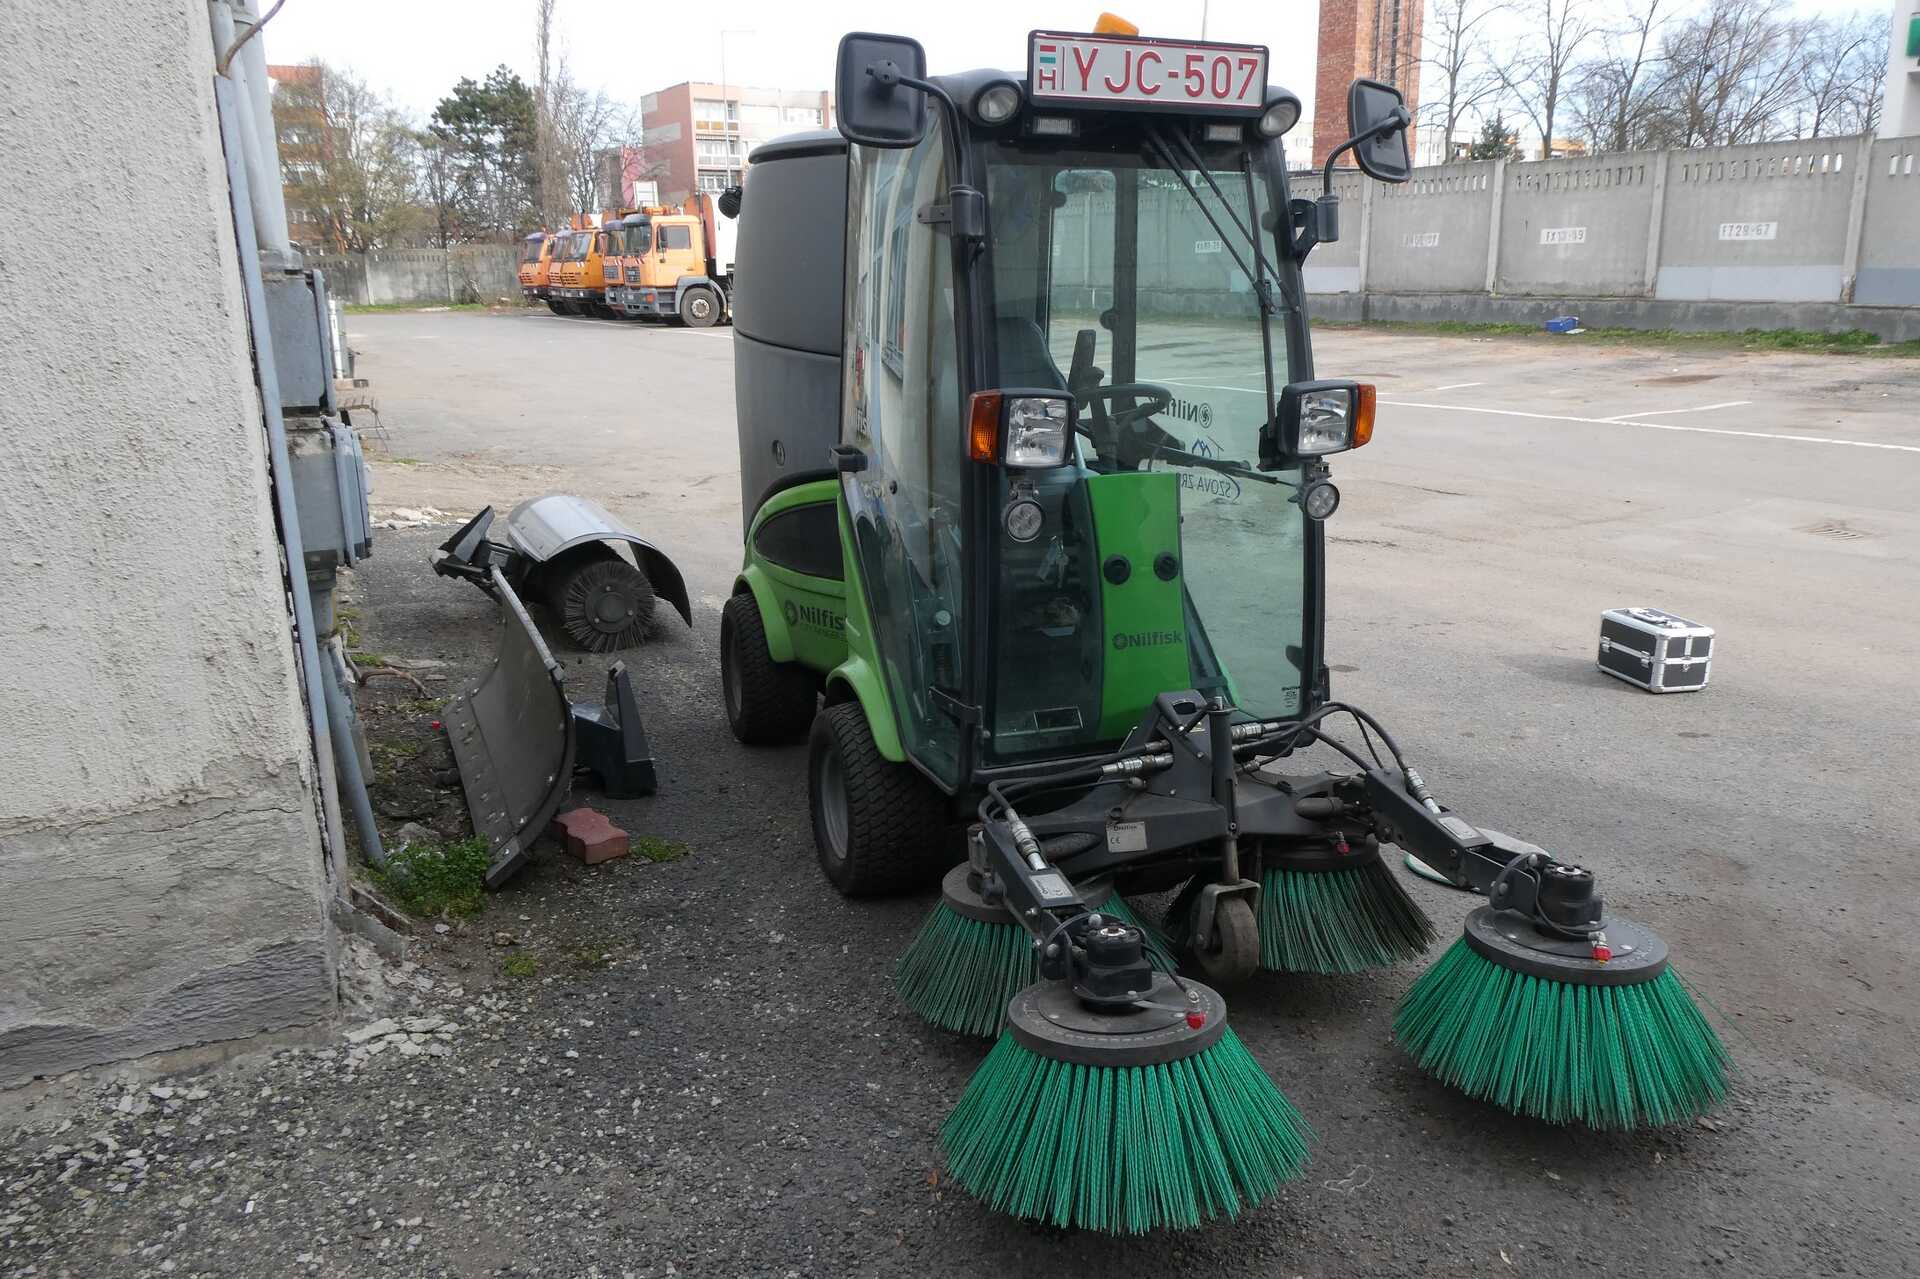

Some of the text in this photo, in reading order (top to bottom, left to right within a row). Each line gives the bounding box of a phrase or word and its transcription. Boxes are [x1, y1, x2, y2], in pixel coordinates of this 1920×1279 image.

[1038, 47, 1259, 100] H YJC-507
[800, 604, 848, 631] Nilfis
[1129, 630, 1183, 647] Nilfisk
